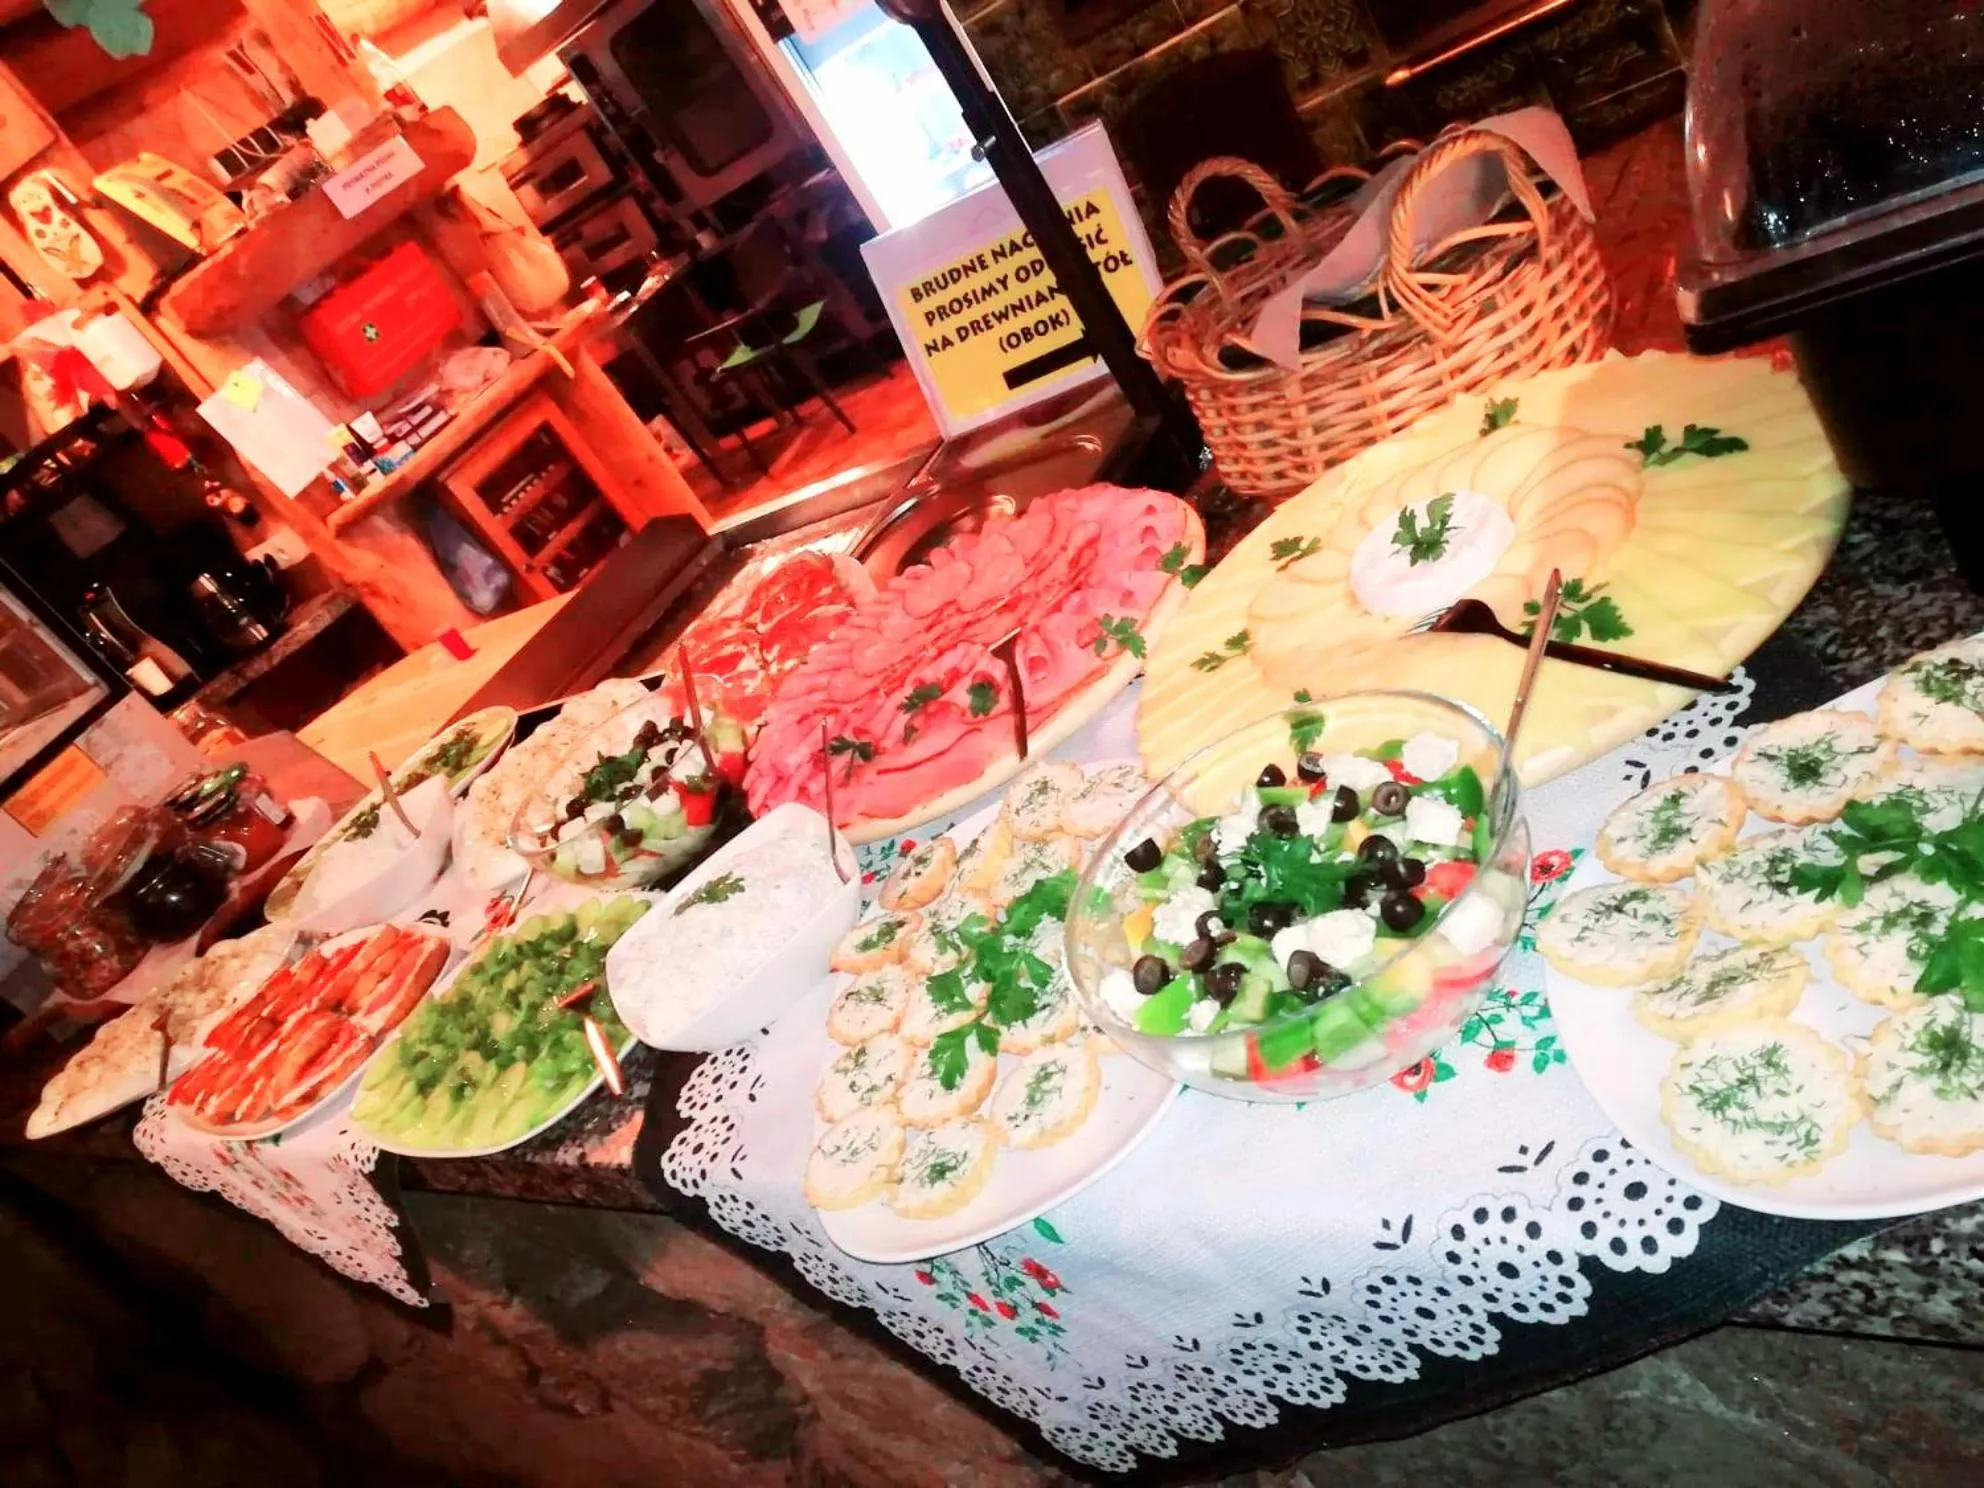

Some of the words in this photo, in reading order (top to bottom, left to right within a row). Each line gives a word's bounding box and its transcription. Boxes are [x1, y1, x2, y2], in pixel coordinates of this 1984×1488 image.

[910, 254, 989, 303] BRUDNE
[923, 274, 1009, 327] PROSIMY
[923, 333, 954, 357] NA
[999, 308, 1070, 353] (OBOK)
